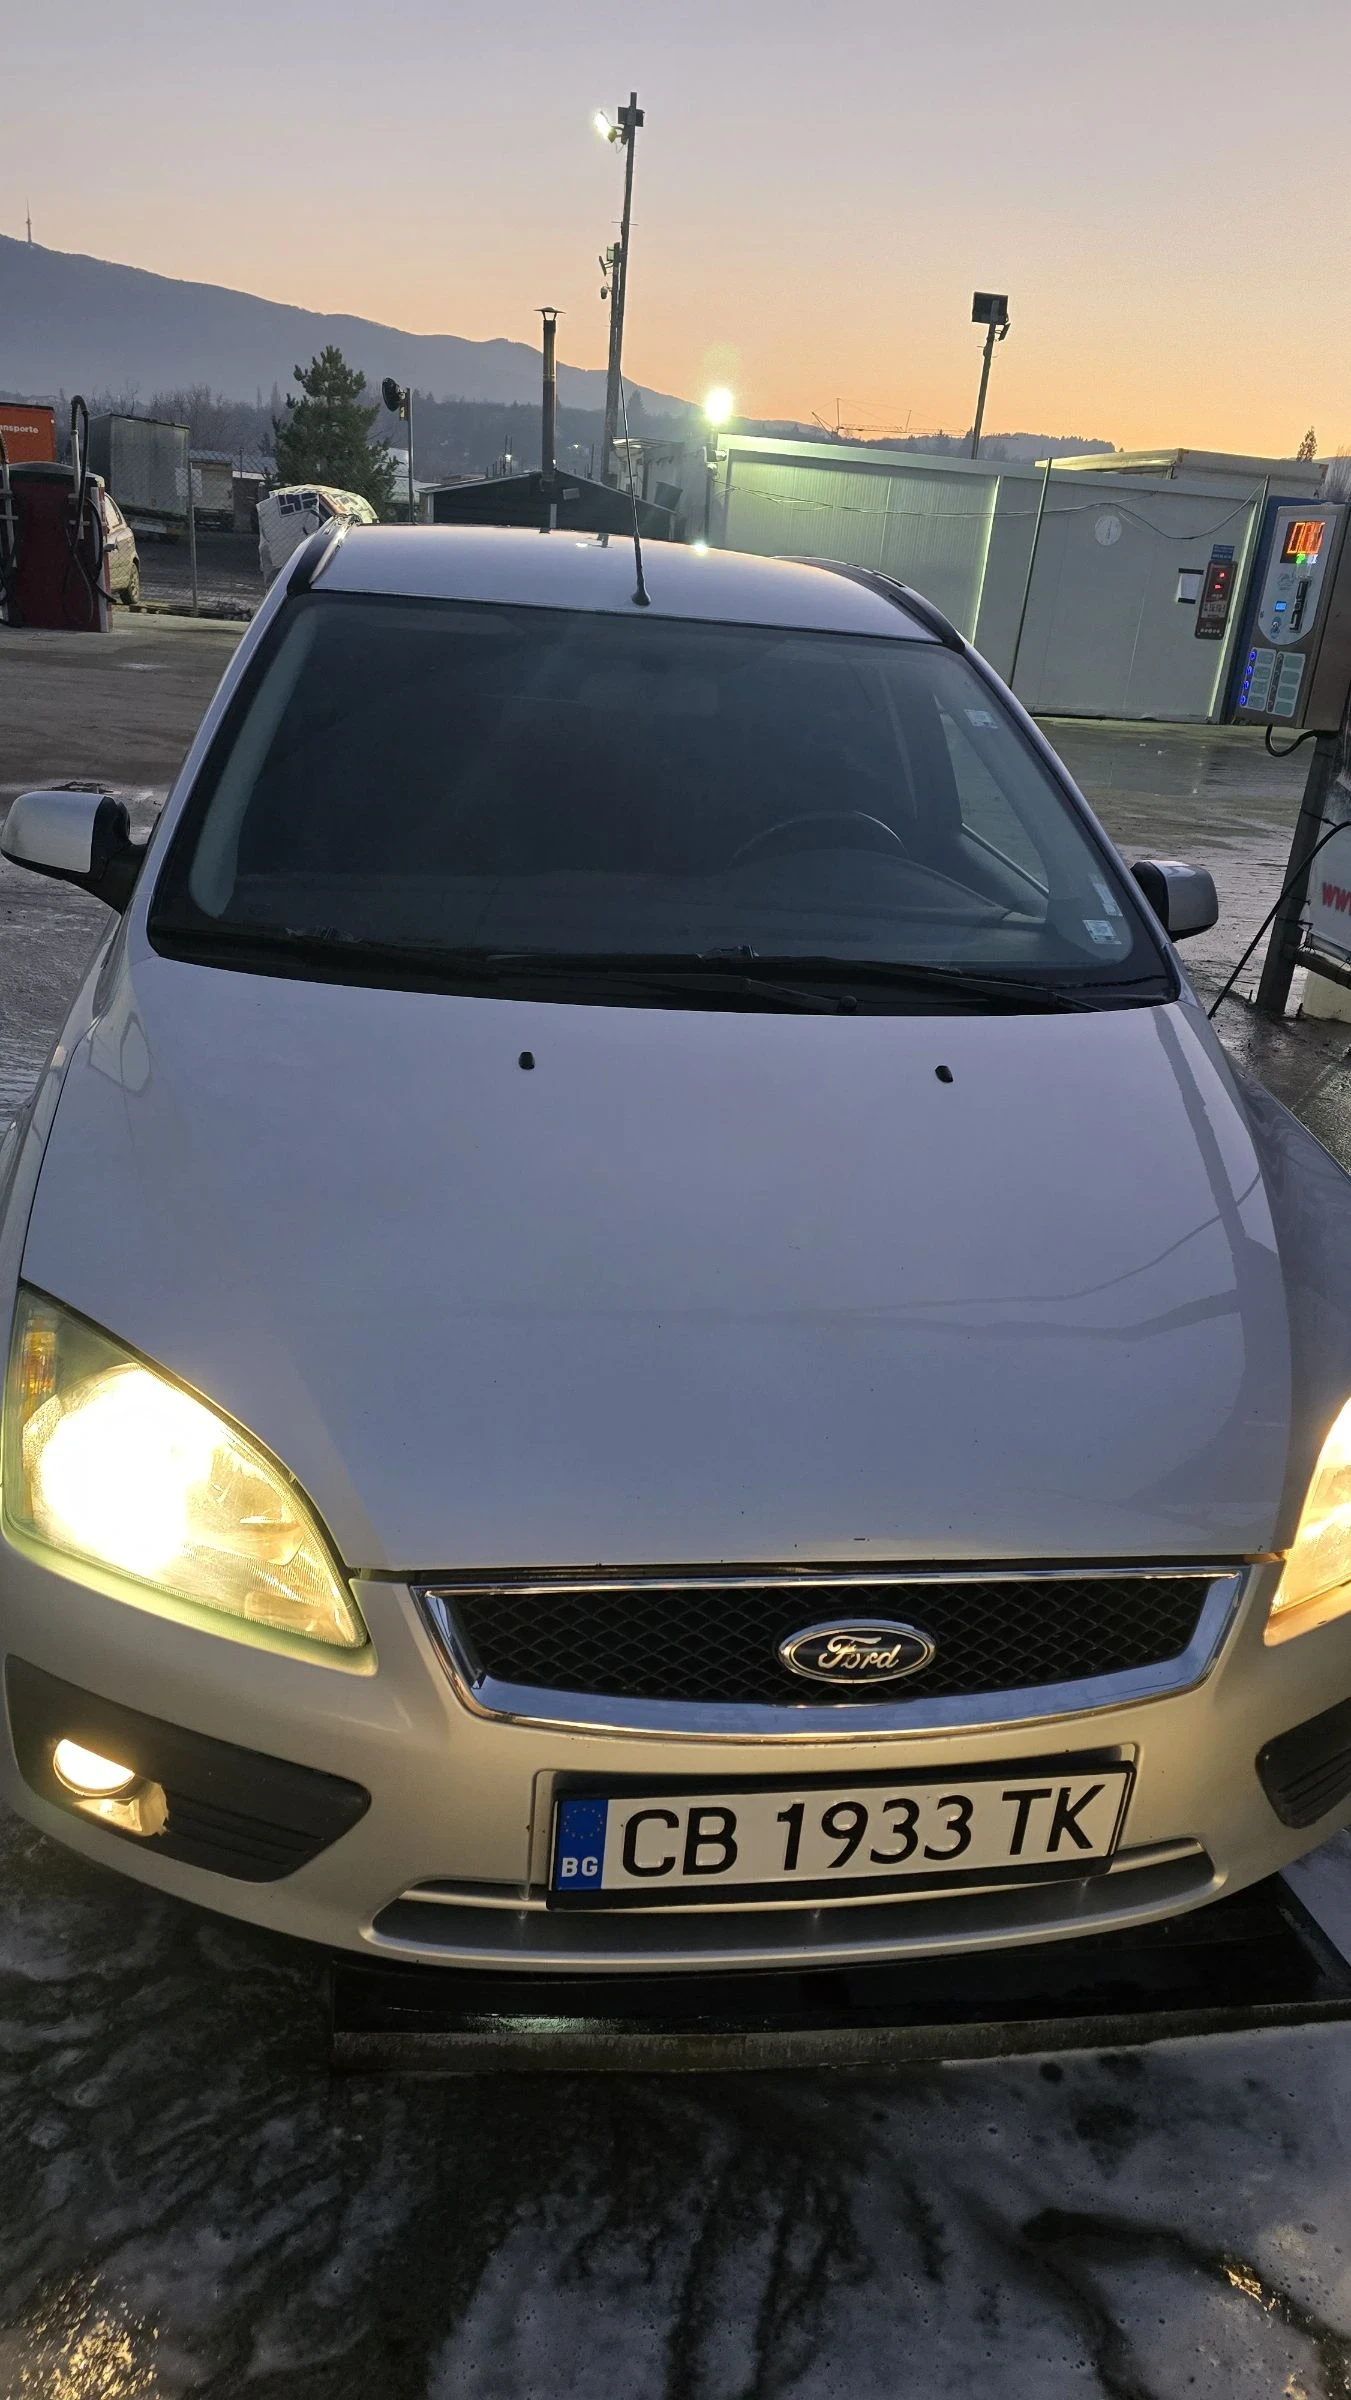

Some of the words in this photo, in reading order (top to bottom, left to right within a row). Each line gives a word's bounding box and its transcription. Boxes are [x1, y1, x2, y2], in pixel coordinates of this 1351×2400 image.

[818, 1635, 902, 1669] Ford
[621, 1806, 738, 1877] CB
[776, 1795, 974, 1871] 1933
[1001, 1784, 1105, 1856] TK
[561, 1856, 598, 1878] BG
